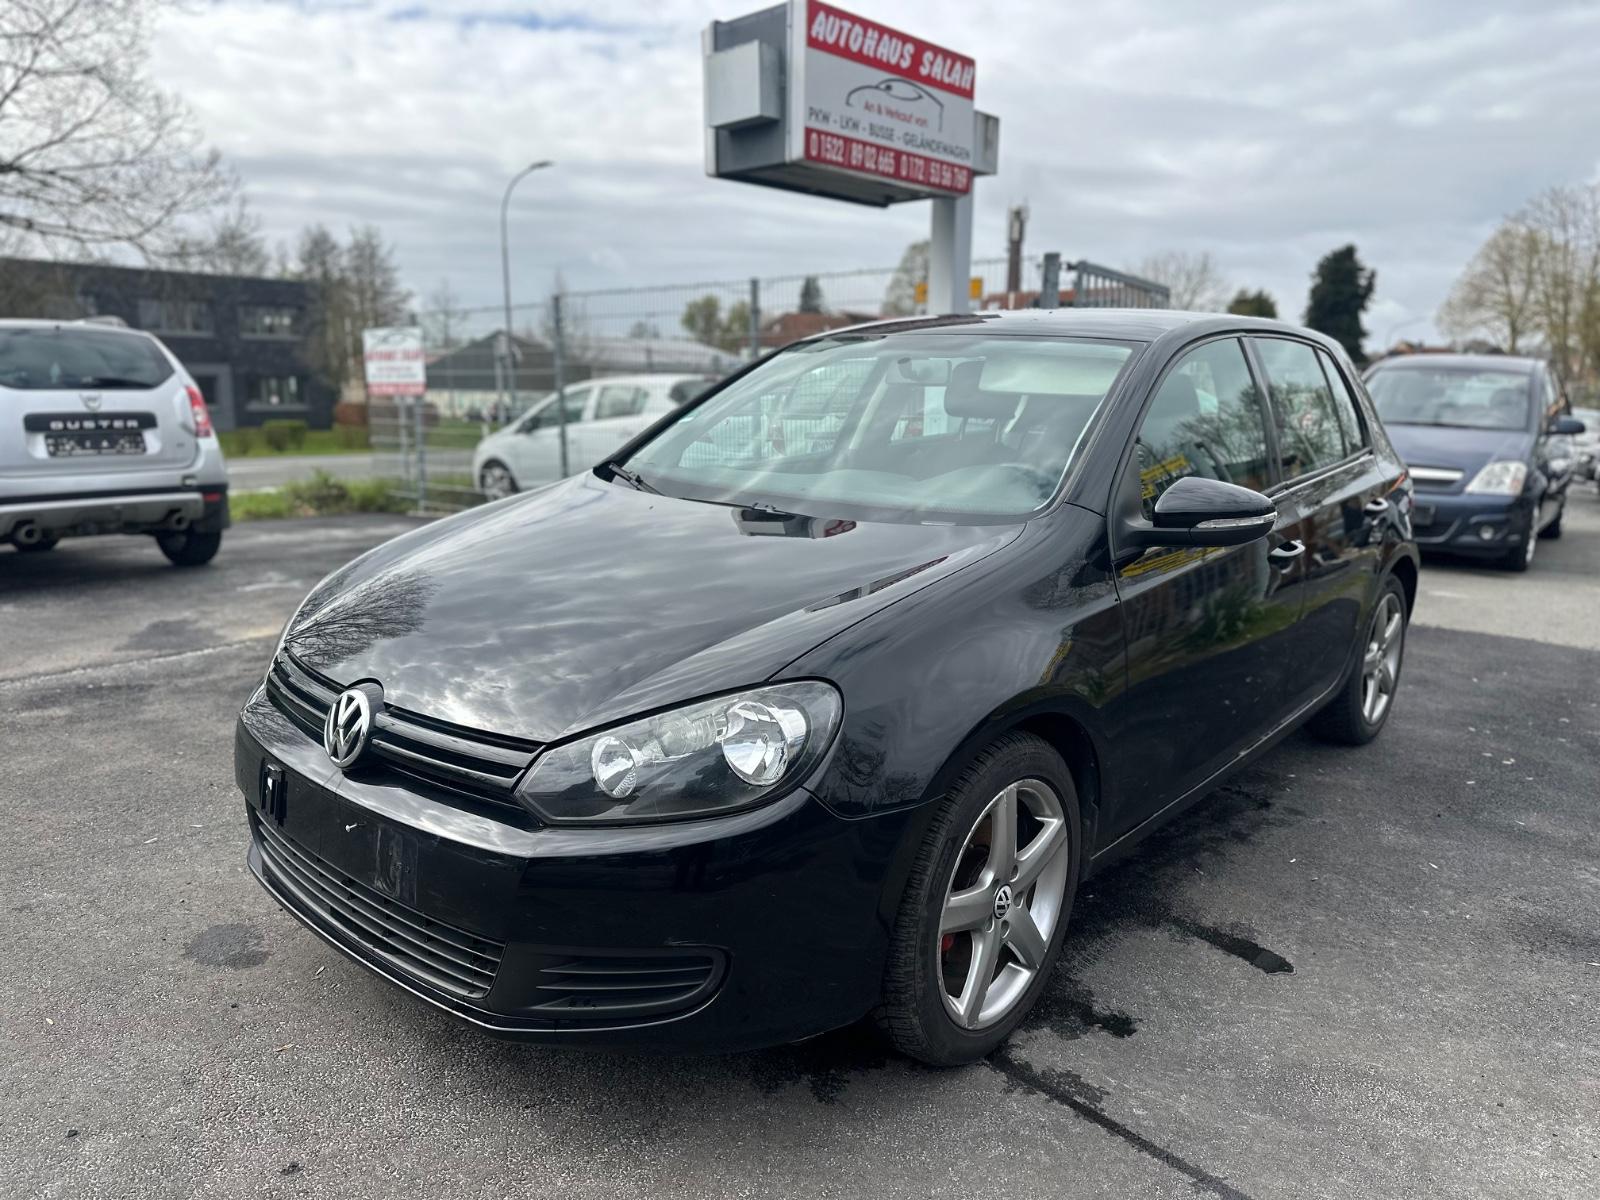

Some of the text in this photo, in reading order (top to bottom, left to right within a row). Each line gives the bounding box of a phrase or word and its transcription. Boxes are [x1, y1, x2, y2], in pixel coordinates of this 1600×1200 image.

[811, 10, 974, 91] AUTOHAUS SALAH
[884, 105, 913, 122] Verkauf
[808, 106, 830, 124] PKW
[840, 115, 860, 132] LKW
[869, 122, 895, 142] BUSSE
[903, 131, 970, 161] GELÄNDEWAGEN
[810, 132, 819, 158] 0
[50, 419, 138, 430] DUSTER
